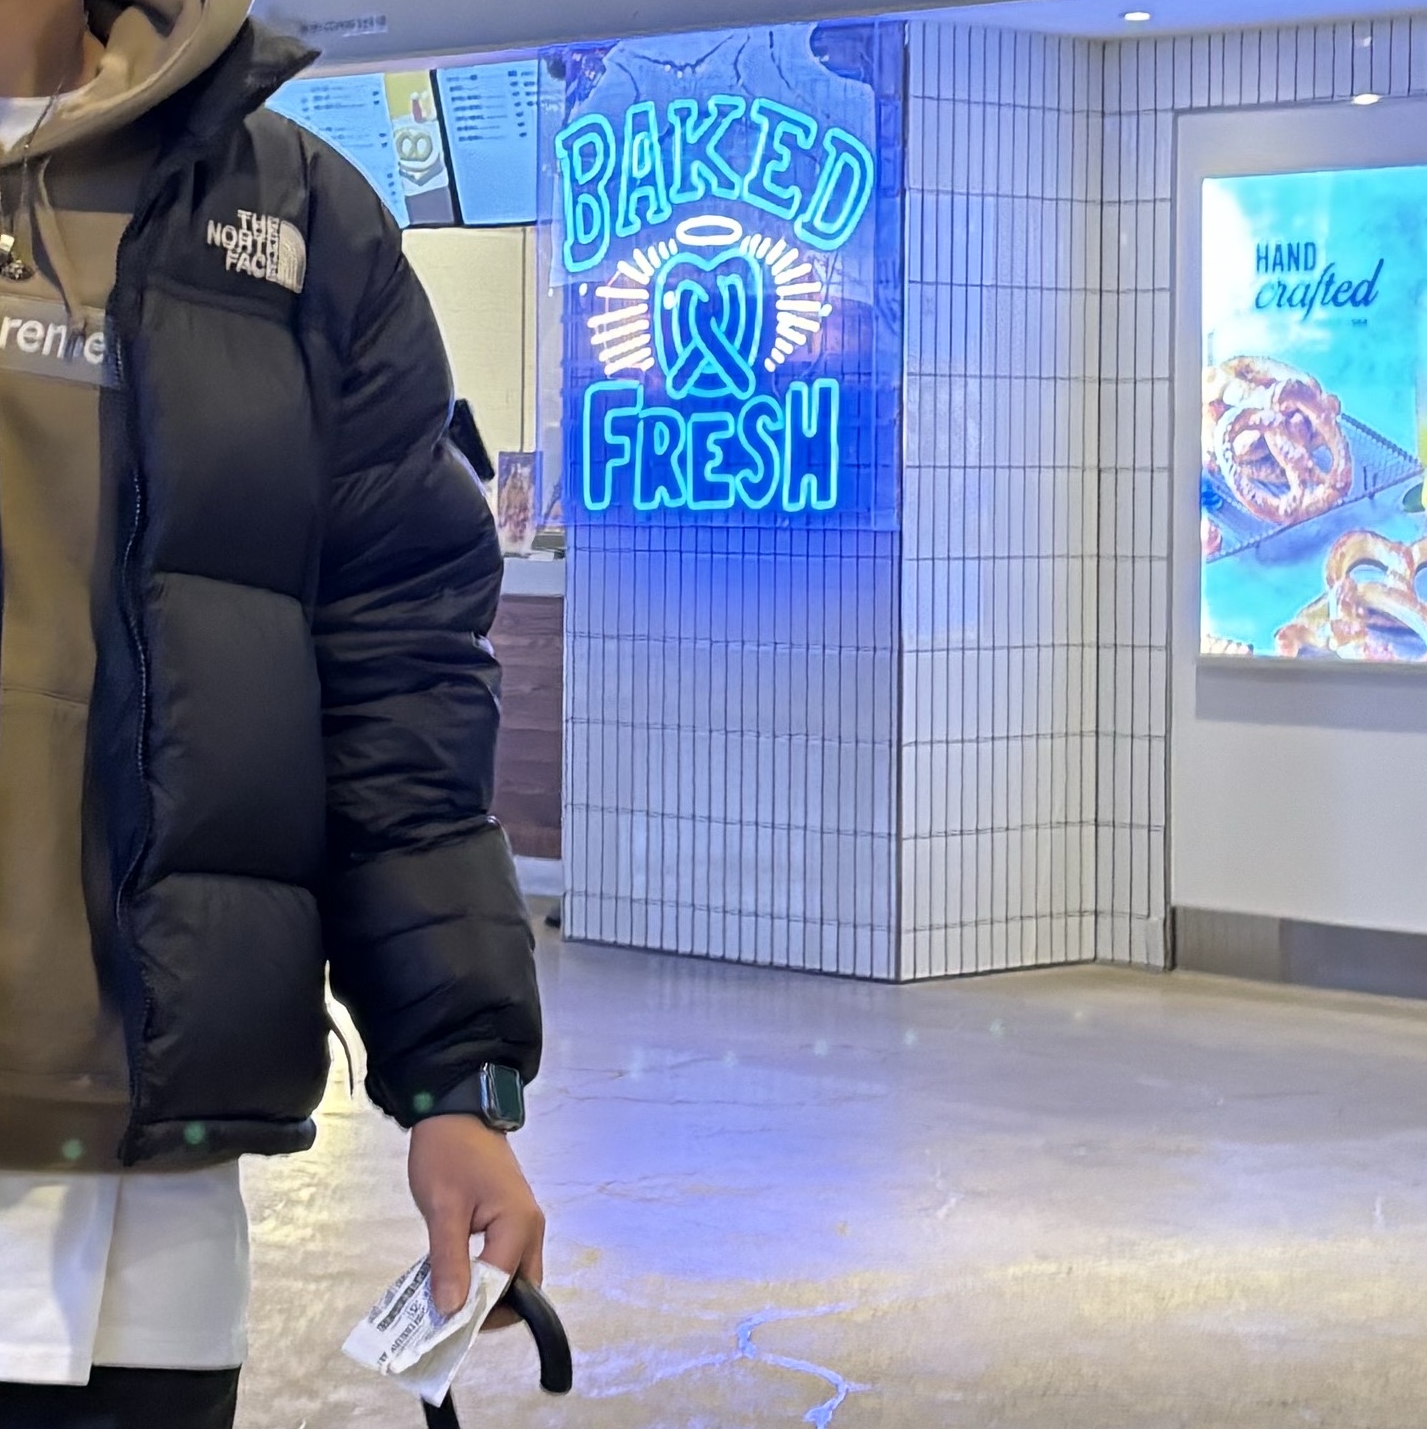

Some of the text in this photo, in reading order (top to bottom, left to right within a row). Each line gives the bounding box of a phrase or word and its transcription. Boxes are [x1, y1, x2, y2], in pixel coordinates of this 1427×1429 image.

[554, 93, 875, 273] BAKED
[206, 219, 280, 260] NORTH
[237, 209, 280, 239] THE
[225, 249, 280, 282] FACE
[1255, 241, 1317, 273] HAND
[1254, 257, 1385, 322] crafted
[583, 378, 840, 512] FRESH
